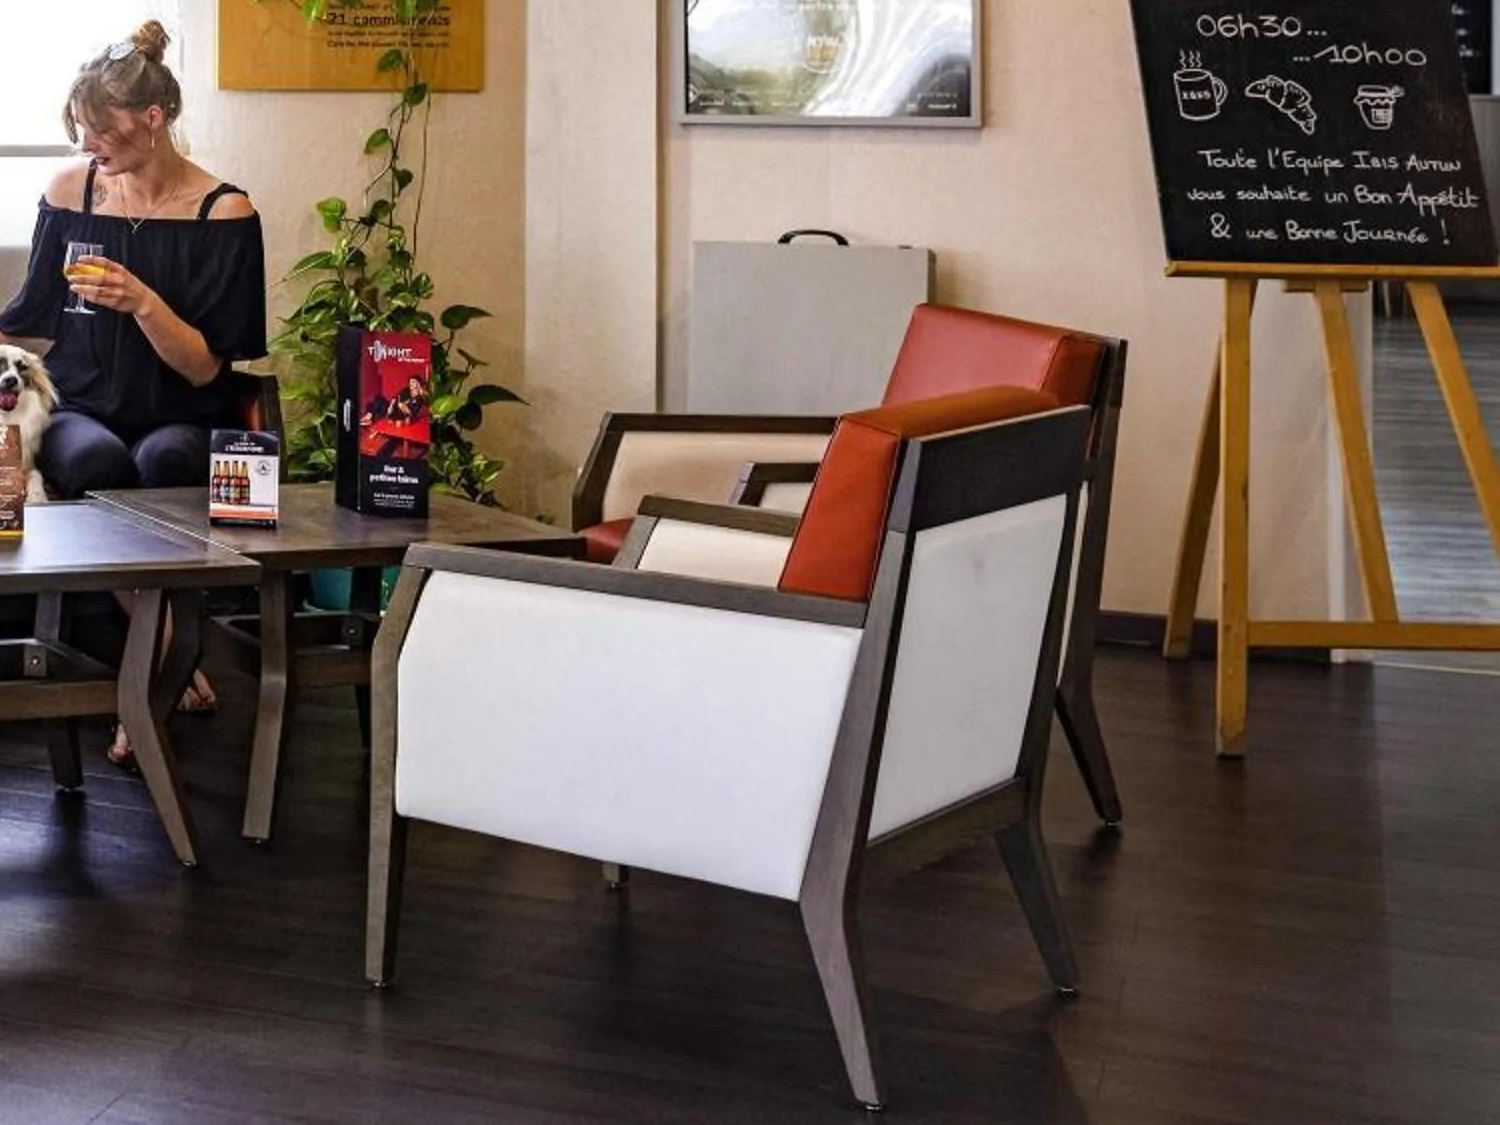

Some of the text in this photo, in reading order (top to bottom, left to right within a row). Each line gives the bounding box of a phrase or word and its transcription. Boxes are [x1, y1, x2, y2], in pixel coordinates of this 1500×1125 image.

[1198, 147, 1258, 168] Toute
[1236, 184, 1313, 202] souhaite
[1325, 192, 1348, 203] un
[1354, 184, 1393, 204] Bon
[1210, 213, 1232, 239] &
[1285, 220, 1337, 241] Bonne
